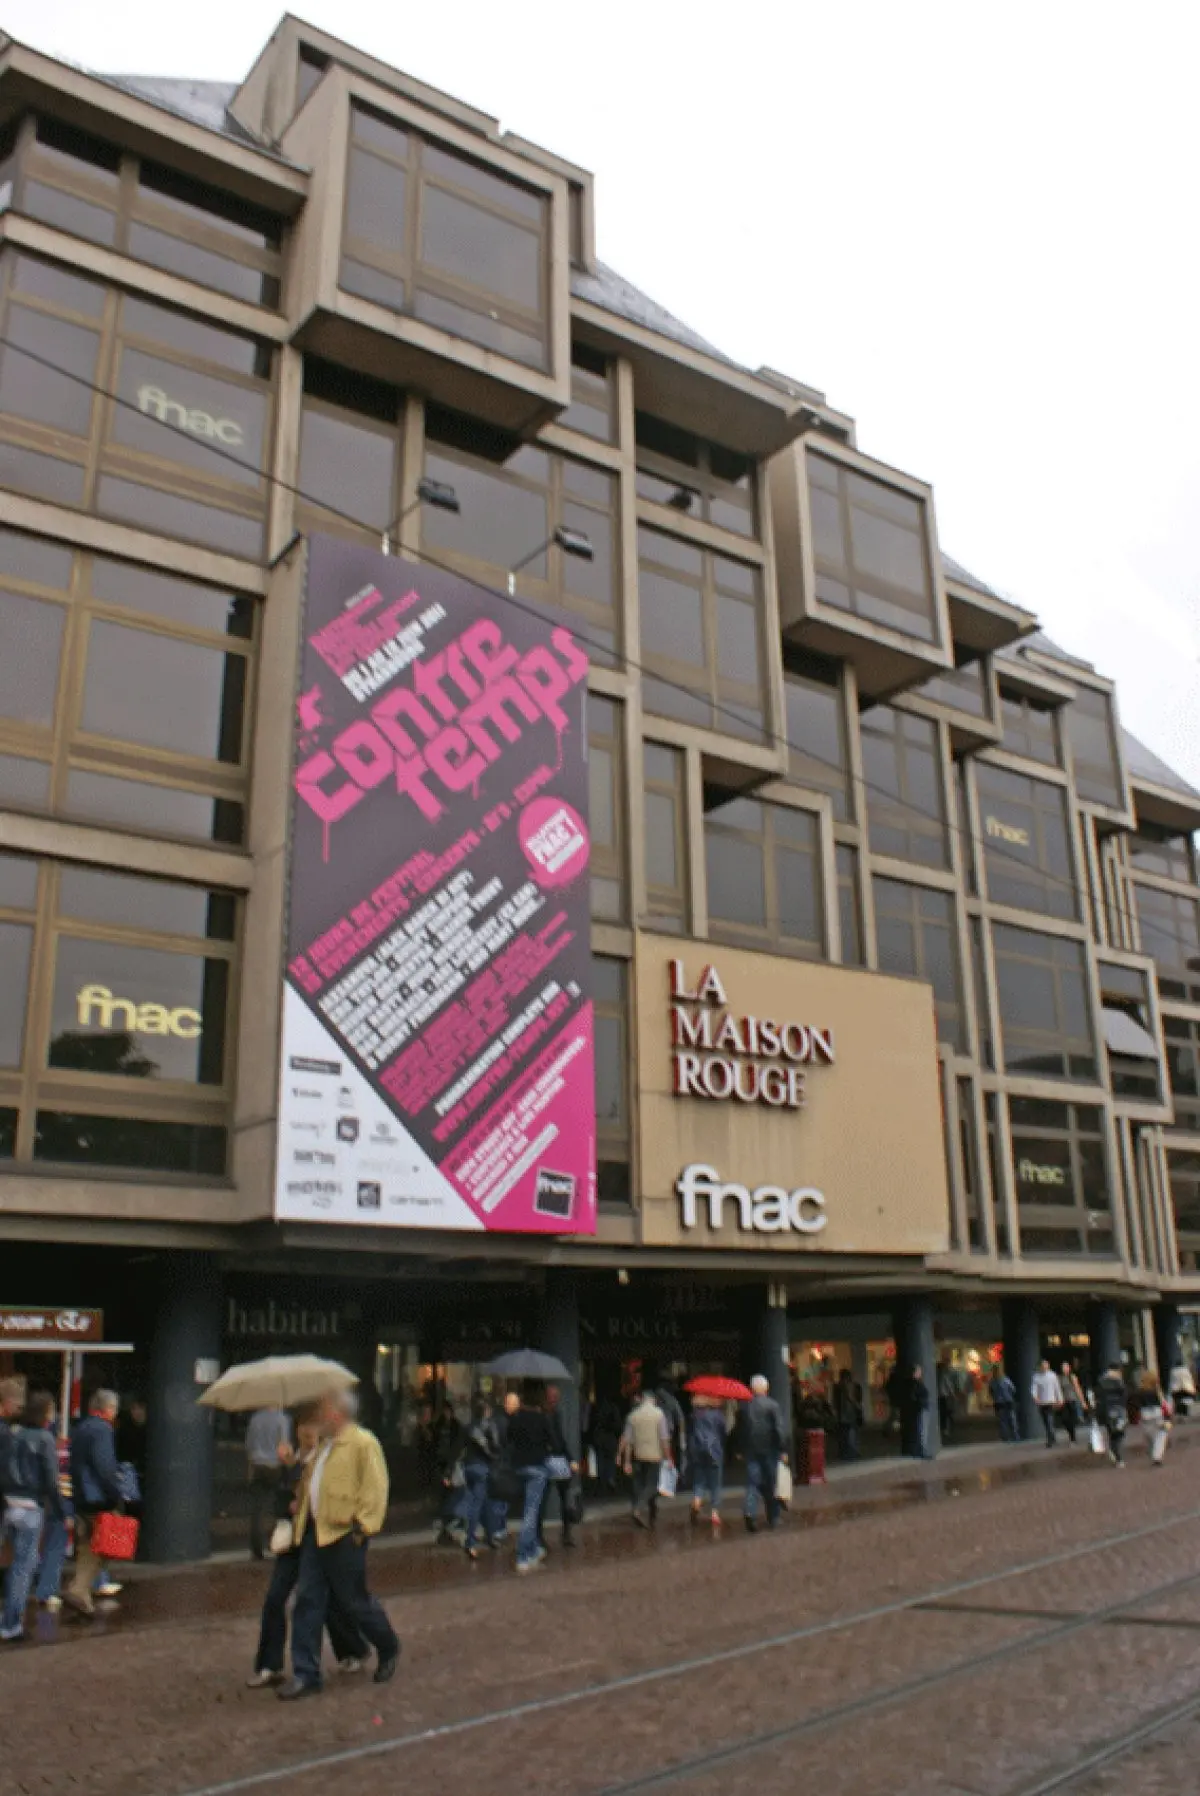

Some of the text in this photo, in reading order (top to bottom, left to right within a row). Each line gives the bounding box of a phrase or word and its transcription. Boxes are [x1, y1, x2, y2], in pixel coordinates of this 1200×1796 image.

[138, 385, 244, 446] fnac
[295, 617, 521, 822] contre
[669, 959, 727, 1005] LA
[76, 984, 203, 1039] fnac
[670, 1006, 834, 1064] MAISON
[673, 1053, 806, 1109] ROUGE
[676, 1163, 827, 1233] fnac
[226, 1297, 341, 1337] habitat
